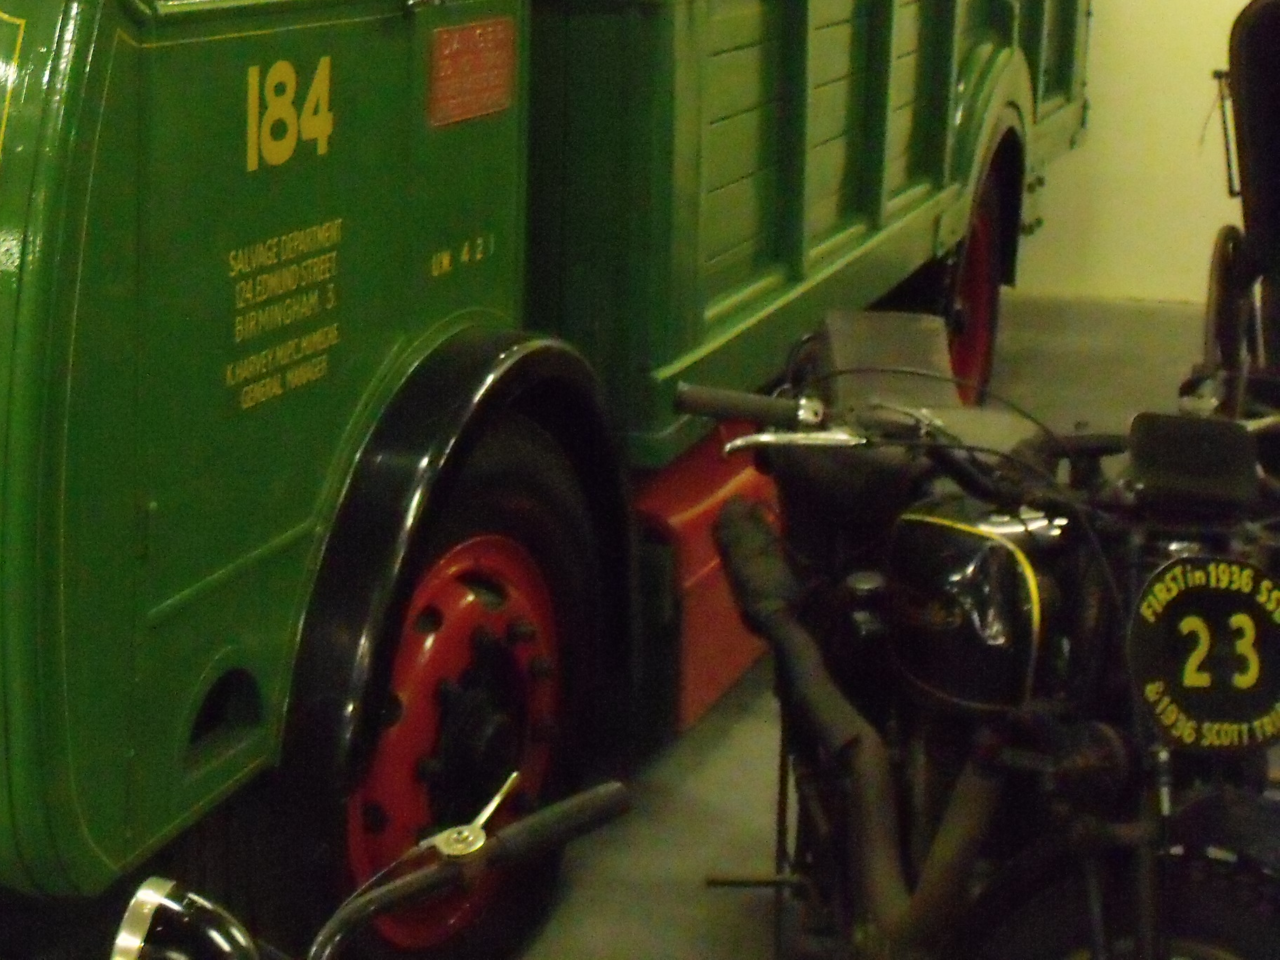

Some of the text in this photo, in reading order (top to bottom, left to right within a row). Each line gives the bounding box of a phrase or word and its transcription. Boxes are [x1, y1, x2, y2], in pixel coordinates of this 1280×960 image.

[246, 55, 334, 172] 184
[300, 249, 337, 286] STREET
[235, 290, 319, 342] BIRMINGHAM
[1140, 565, 1185, 623] FIRST
[1208, 562, 1255, 593] 1936
[1178, 613, 1260, 690] 23
[1201, 722, 1249, 746] SCOTT
